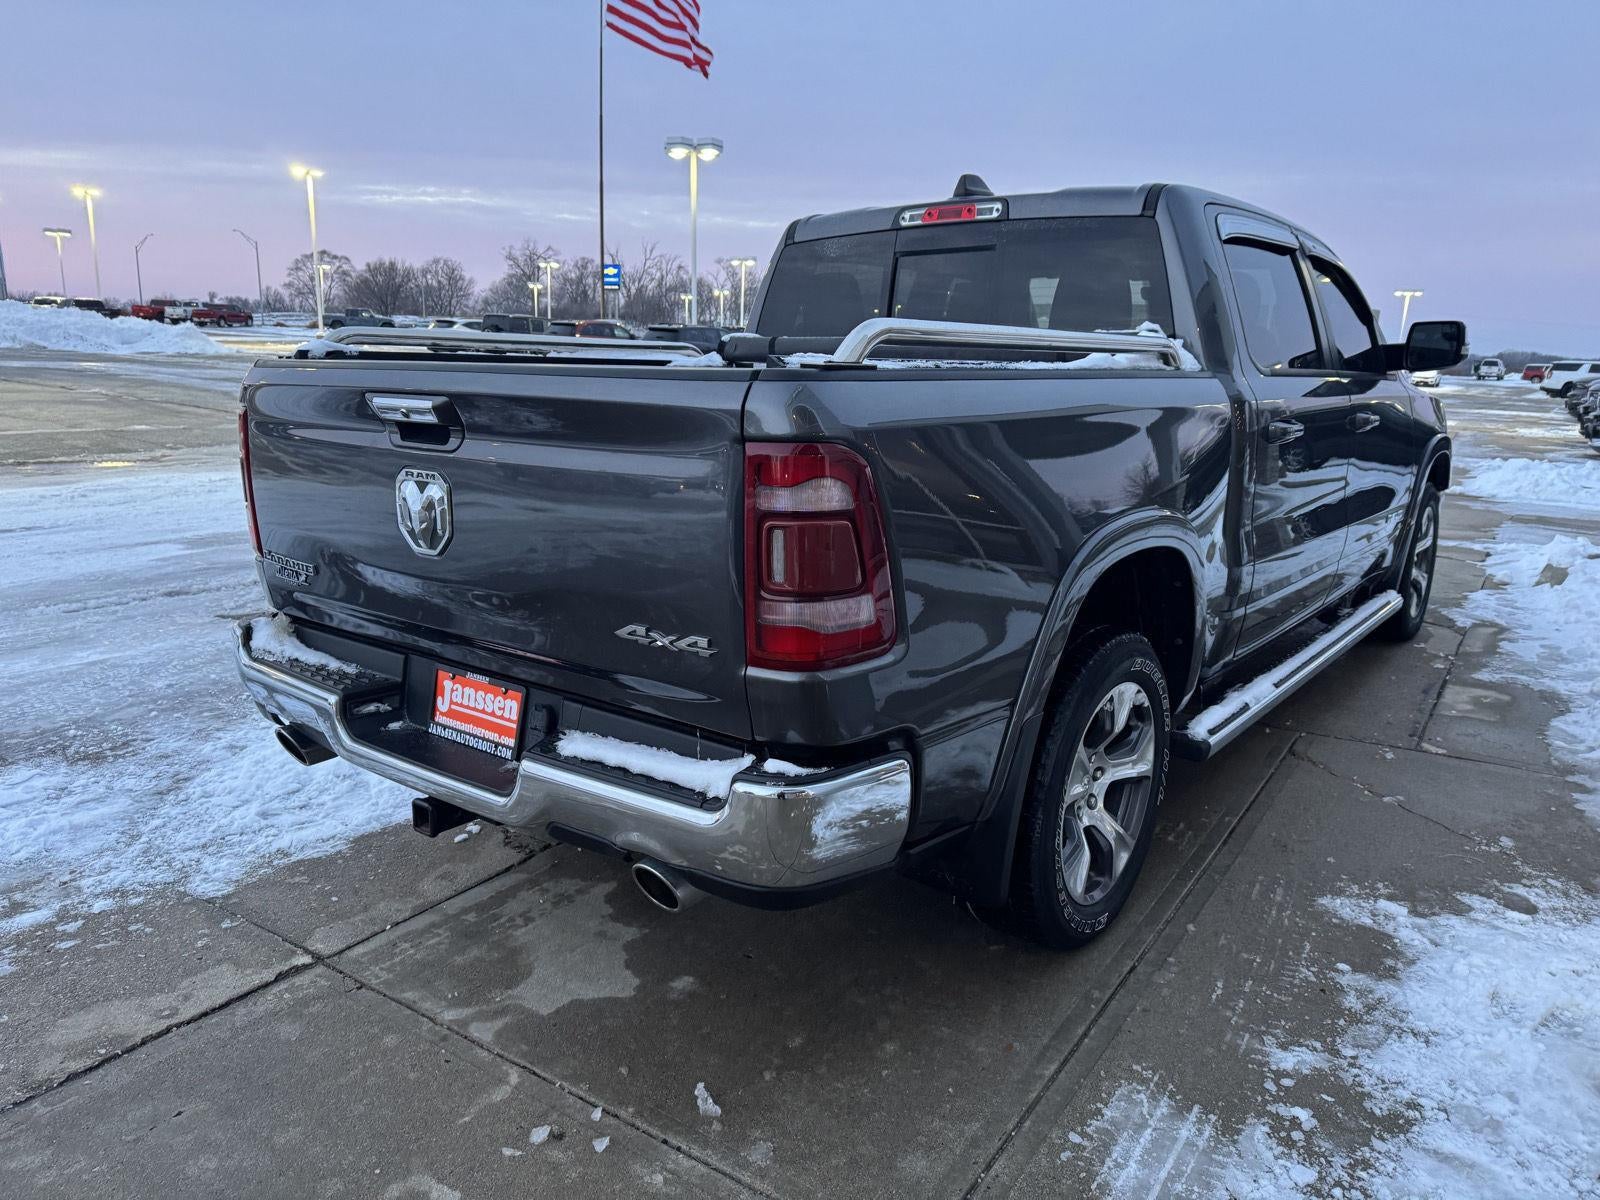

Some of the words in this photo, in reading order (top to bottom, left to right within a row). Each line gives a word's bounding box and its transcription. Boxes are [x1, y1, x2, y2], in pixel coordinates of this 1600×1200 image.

[405, 471, 436, 481] RAM
[264, 550, 313, 576] LARAMIE
[437, 680, 518, 720] Janssen
[1131, 659, 1170, 732] DUELER
[428, 723, 513, 760] JANSSENAUTOGROUP.COM
